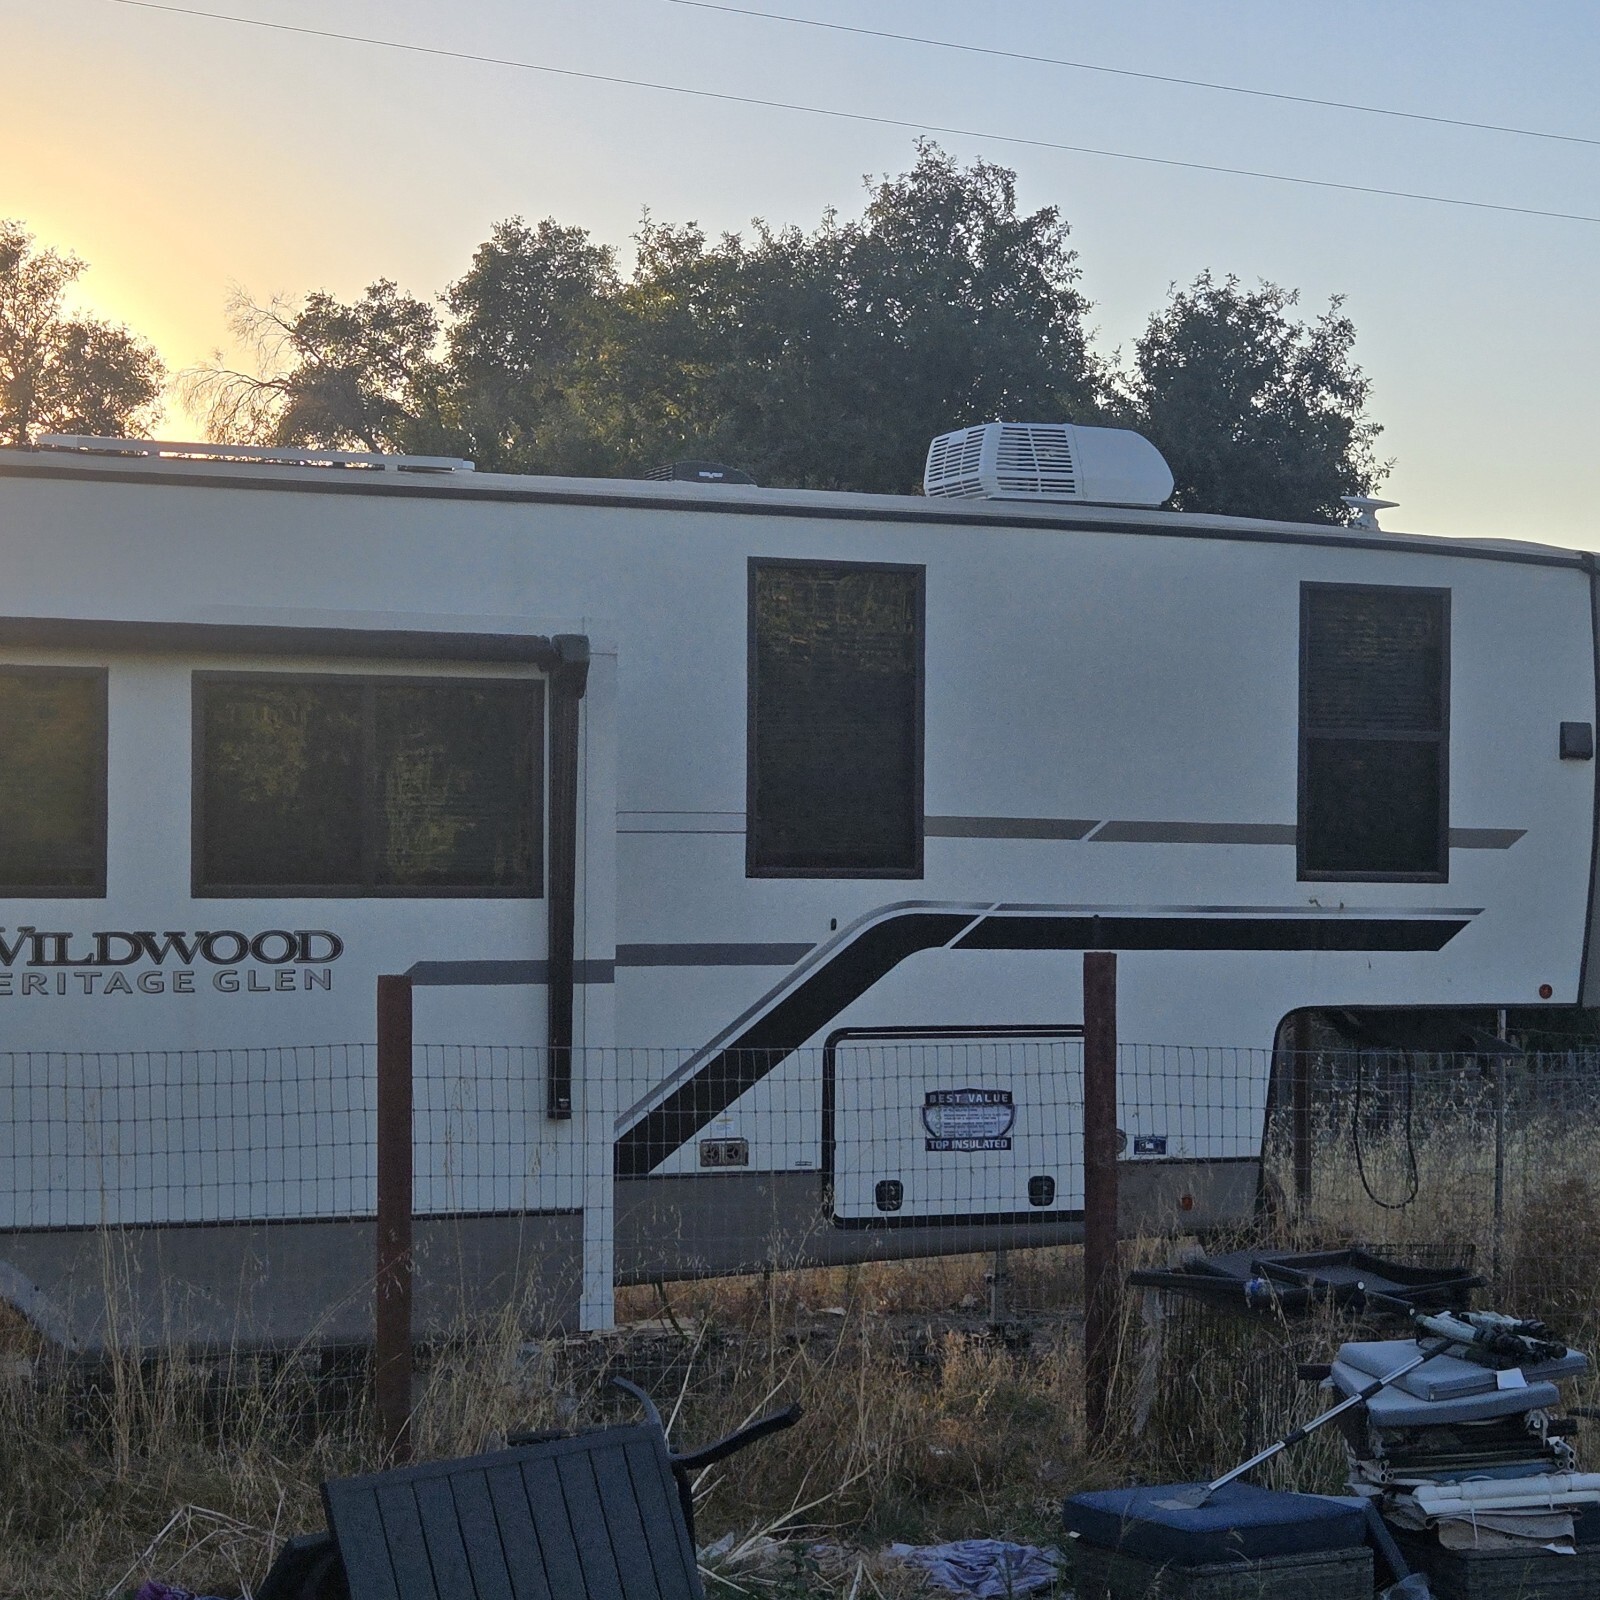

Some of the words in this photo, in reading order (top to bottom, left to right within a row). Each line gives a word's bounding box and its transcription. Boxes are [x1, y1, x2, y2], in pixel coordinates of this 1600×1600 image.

[212, 968, 331, 993] GLEN
[929, 1093, 961, 1103] BEST
[967, 1093, 1009, 1103] VALUE
[929, 1140, 950, 1149] TOP
[951, 1139, 1008, 1149] INSULATED
